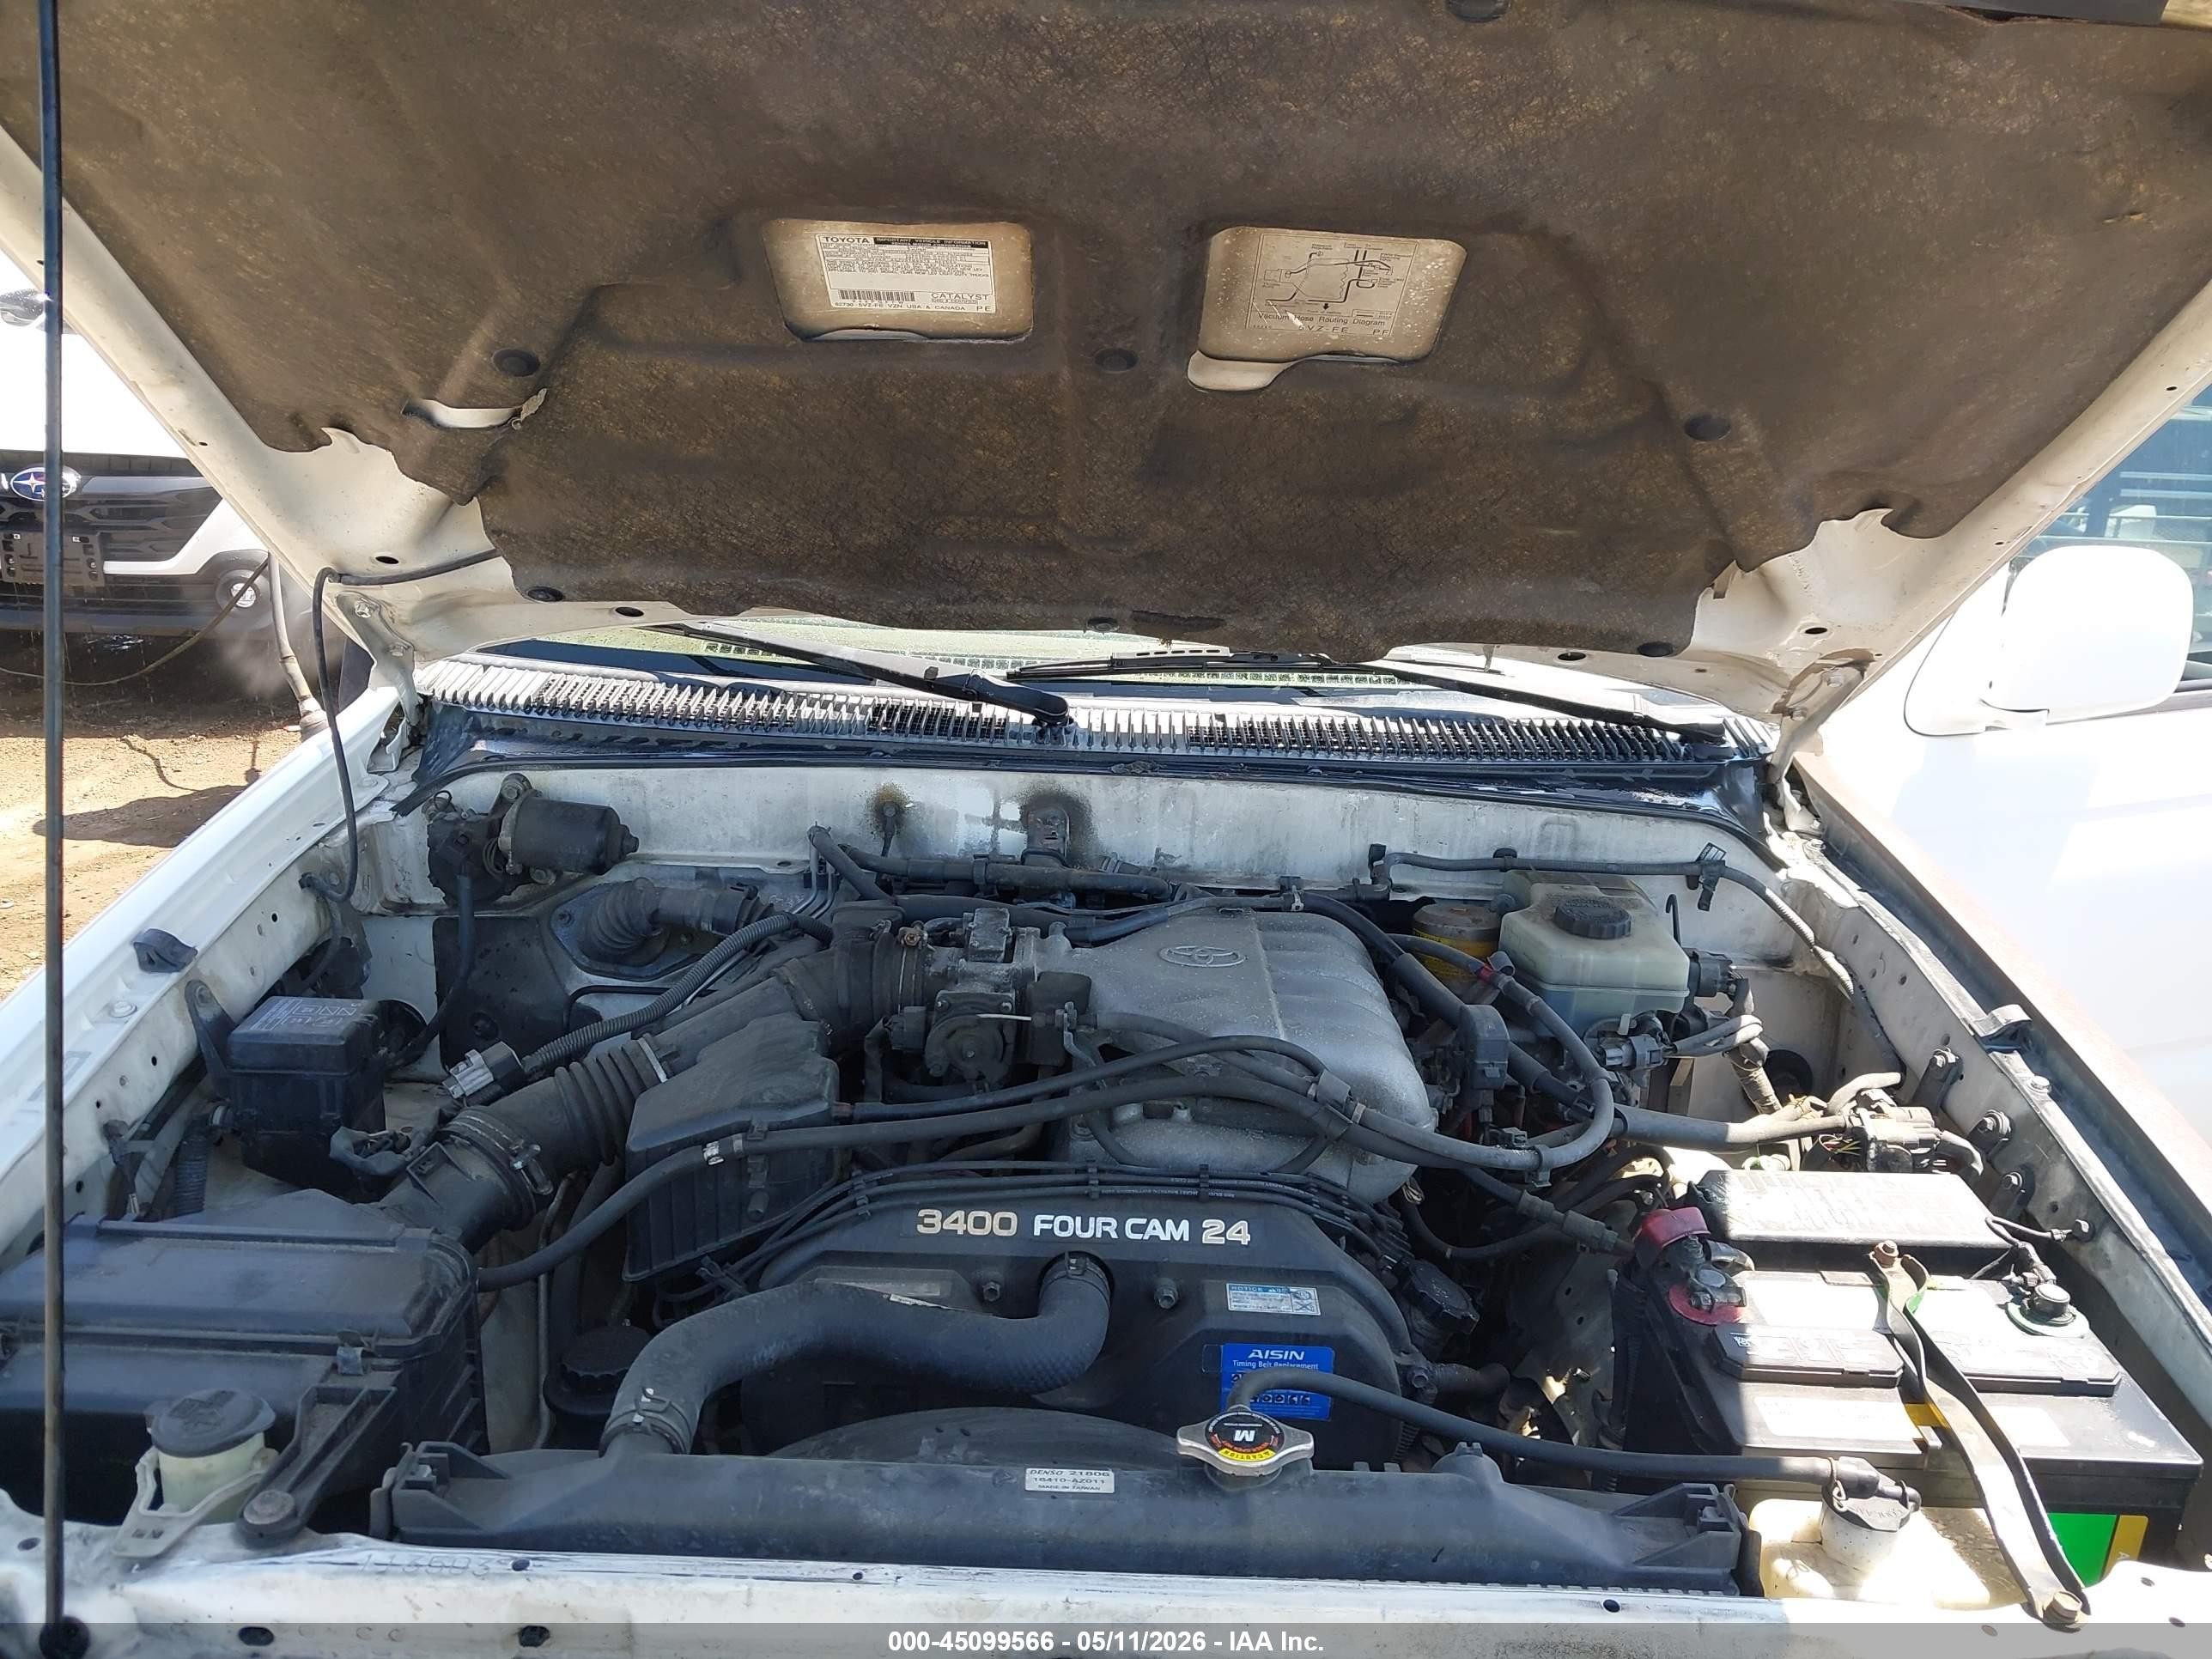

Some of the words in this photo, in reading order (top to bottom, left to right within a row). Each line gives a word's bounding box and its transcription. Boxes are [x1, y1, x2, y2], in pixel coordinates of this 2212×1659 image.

[1259, 312, 1290, 320] Vacuum
[1319, 317, 1348, 325] Routing
[1352, 319, 1386, 327] Diagram
[916, 1209, 1018, 1237] 3400
[1034, 1215, 1118, 1240] FOUR
[1125, 1218, 1190, 1242] CAM
[1202, 1219, 1251, 1246] 24
[1248, 1349, 1305, 1361] AISIN
[1232, 1359, 1256, 1369] Timing
[1258, 1360, 1273, 1369] Belt
[1233, 1430, 1256, 1442] M
[1224, 1449, 1264, 1460] CAUTION
